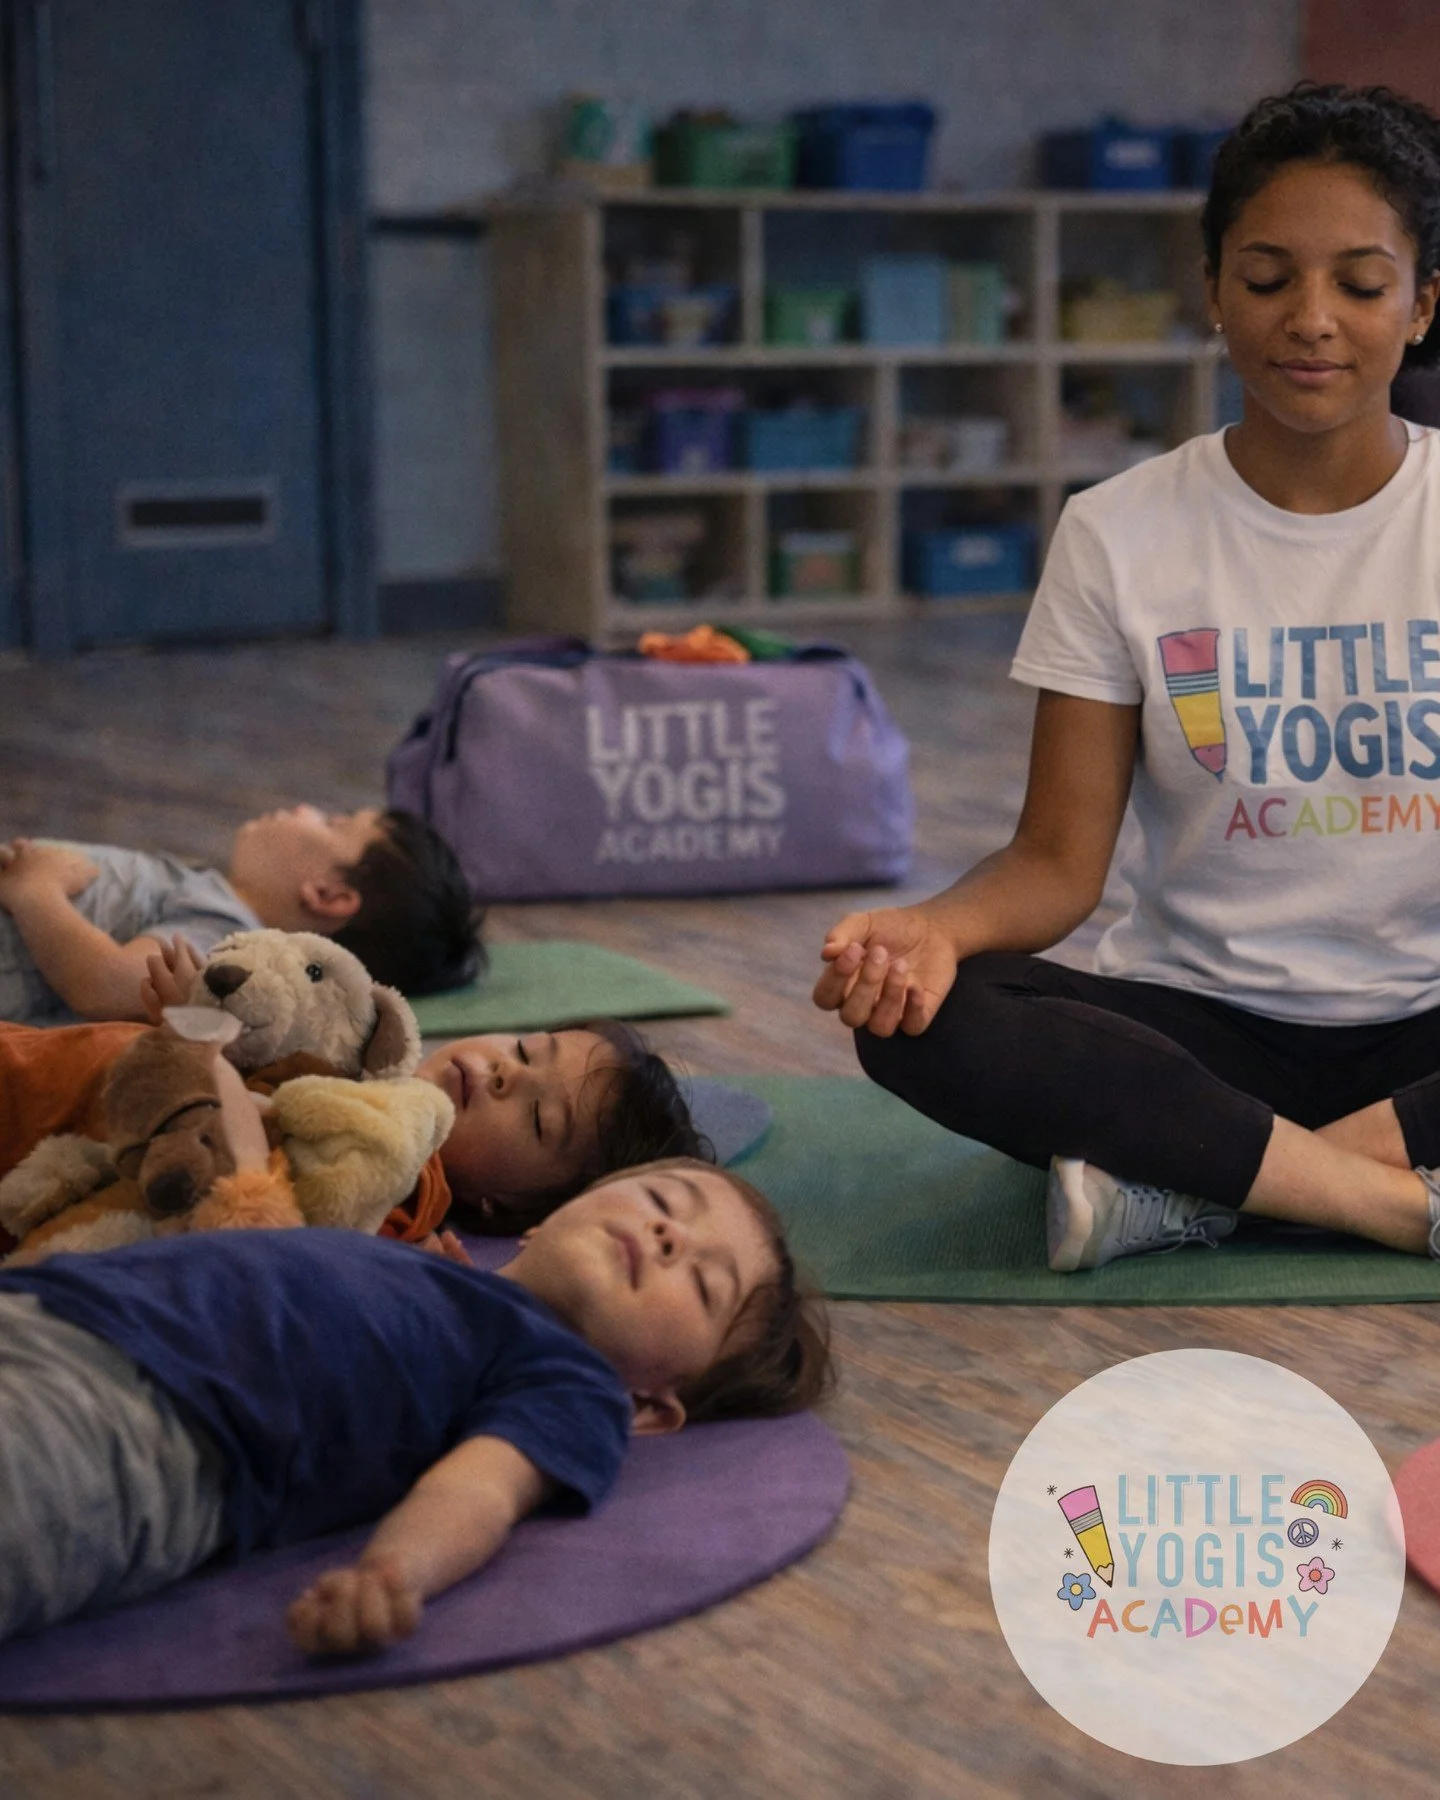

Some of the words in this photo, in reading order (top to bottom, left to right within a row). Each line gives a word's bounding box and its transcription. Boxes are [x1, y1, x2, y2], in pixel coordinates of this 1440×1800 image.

[1233, 619, 1440, 699] LITTLE
[587, 700, 778, 761] LITTLE
[1234, 699, 1440, 785] YOGIS
[591, 759, 785, 822] YOGIS
[596, 826, 783, 863] ACADEMY
